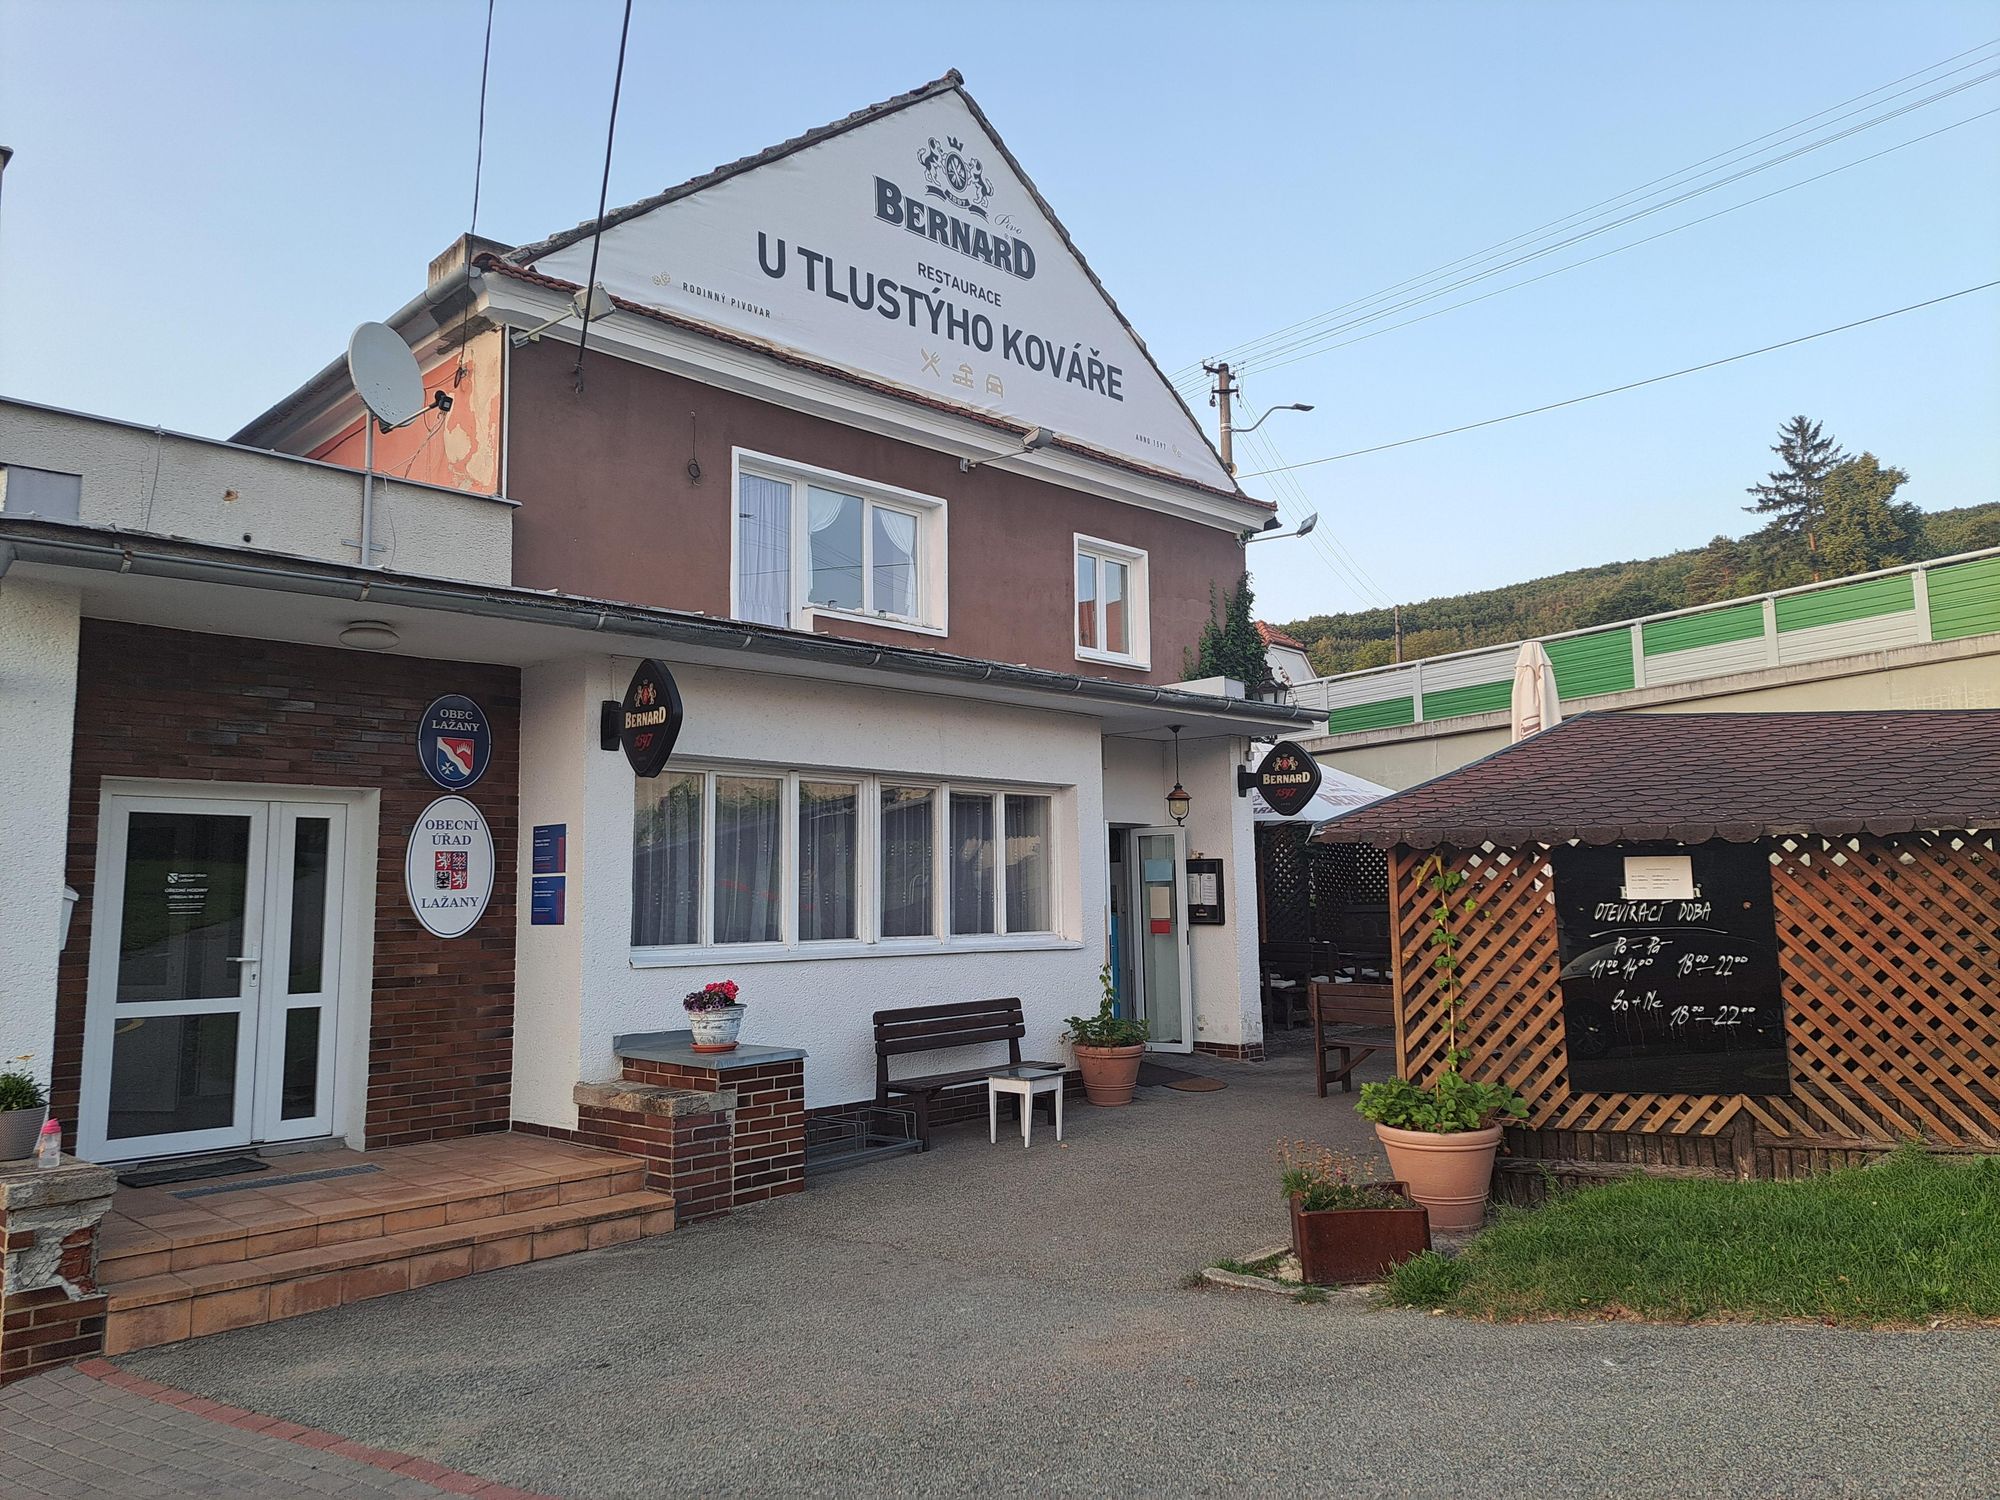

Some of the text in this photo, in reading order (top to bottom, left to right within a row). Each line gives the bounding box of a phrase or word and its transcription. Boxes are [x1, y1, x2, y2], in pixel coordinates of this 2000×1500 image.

[873, 175, 1036, 281] BERNARD
[995, 214, 1022, 234] Pivo
[918, 262, 1002, 307] RESTAURACE
[682, 282, 771, 318] RODINNÝ PIVOVAR
[758, 231, 1124, 402] U TLUSTÝHO KOVÁŘE
[439, 709, 473, 720] OBEC
[625, 706, 666, 729] BERNARD
[431, 719, 480, 732] LAŽANY
[1262, 771, 1311, 785] BERNARD
[425, 817, 479, 831] OBECNÍ
[431, 832, 472, 846] ÚŘAD
[421, 895, 480, 909] LAŽANY
[1678, 901, 1712, 922] DOBA
[1614, 937, 1627, 955] Po
